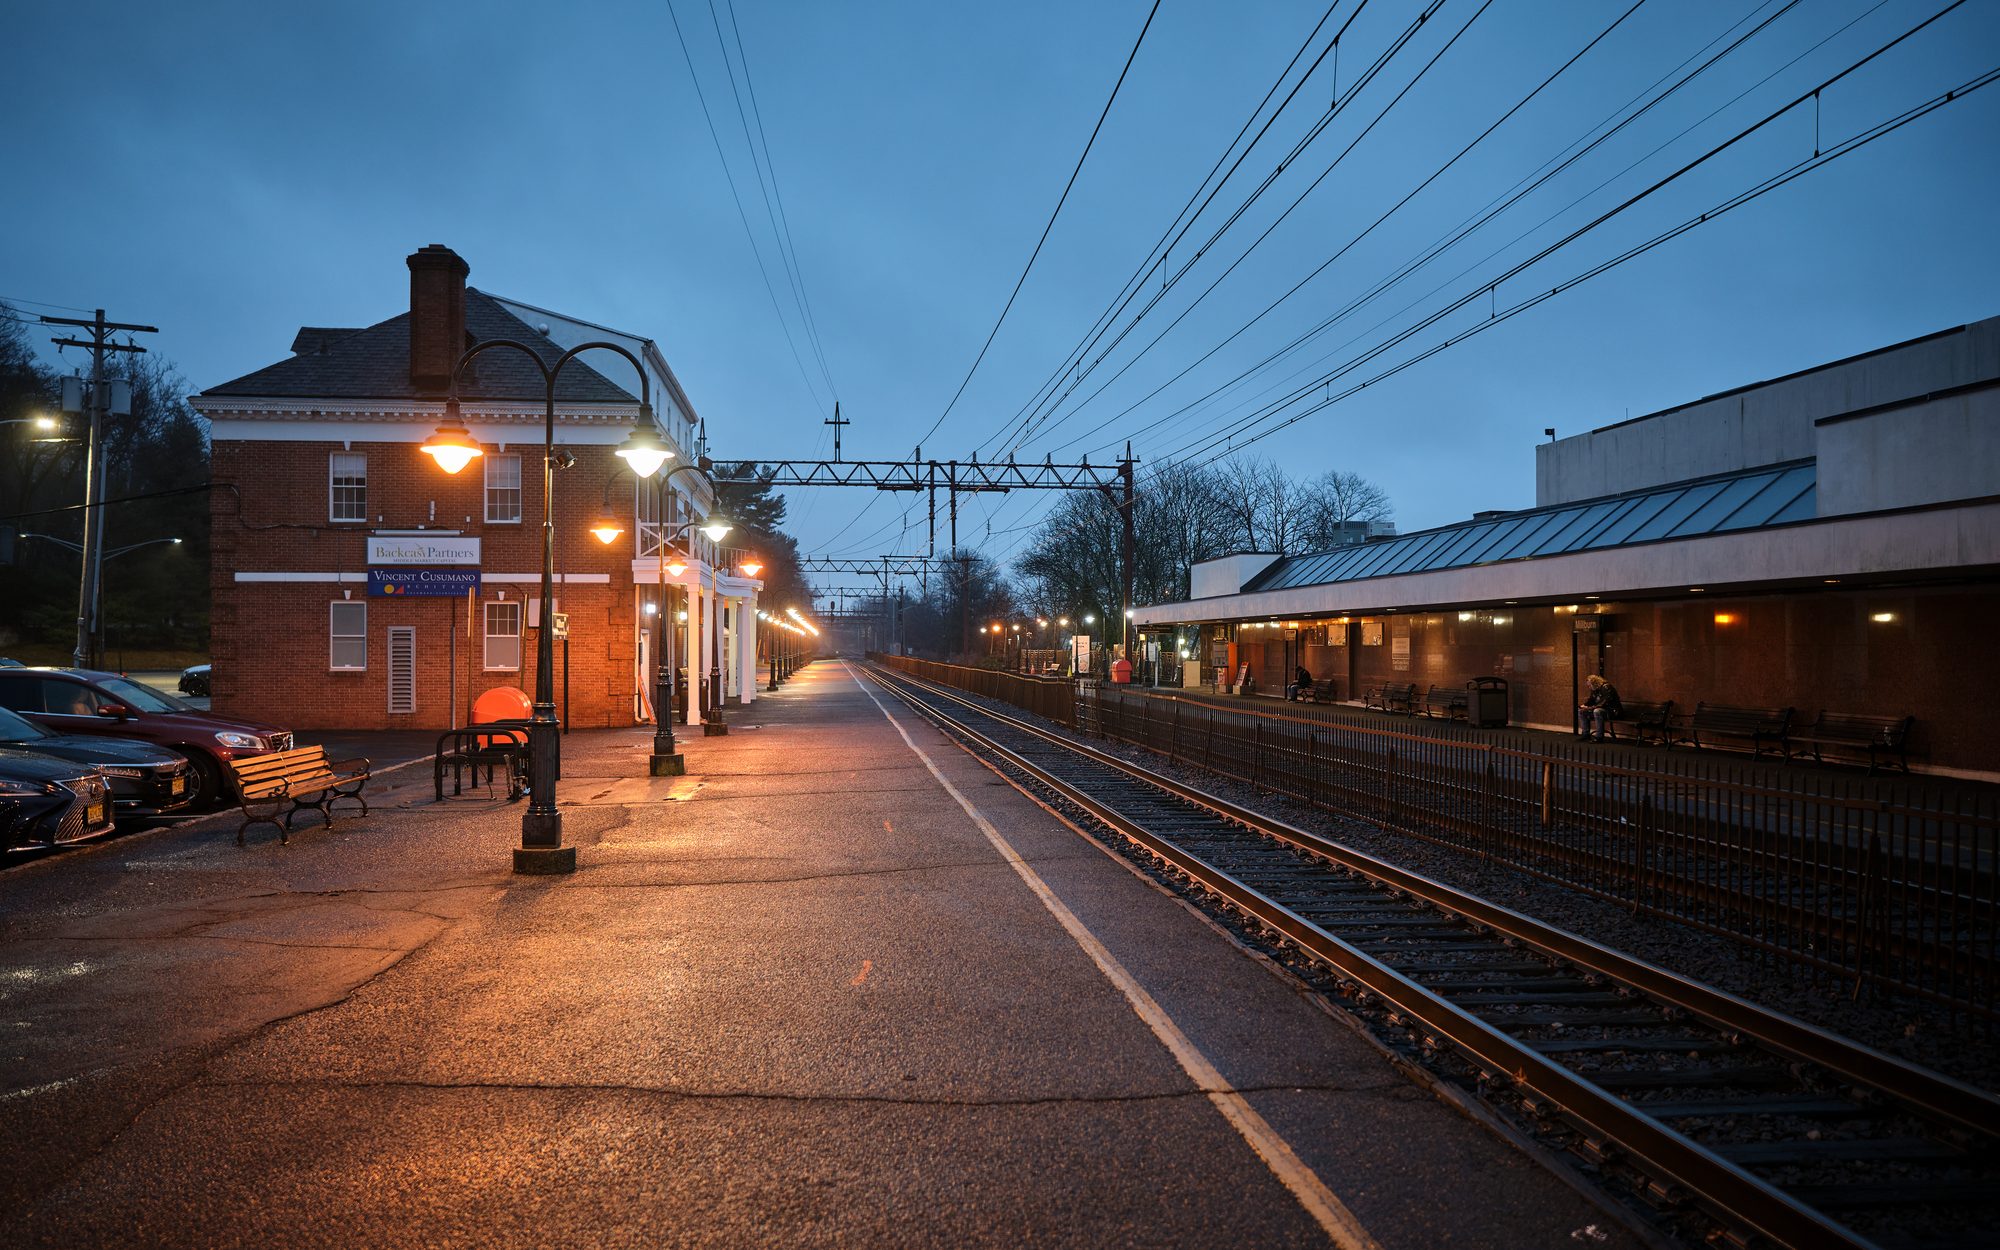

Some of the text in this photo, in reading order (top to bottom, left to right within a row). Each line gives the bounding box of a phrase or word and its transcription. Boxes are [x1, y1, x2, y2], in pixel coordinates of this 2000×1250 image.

[428, 547, 474, 558] Partners
[374, 571, 476, 582] VINCENT CUSUMANO
